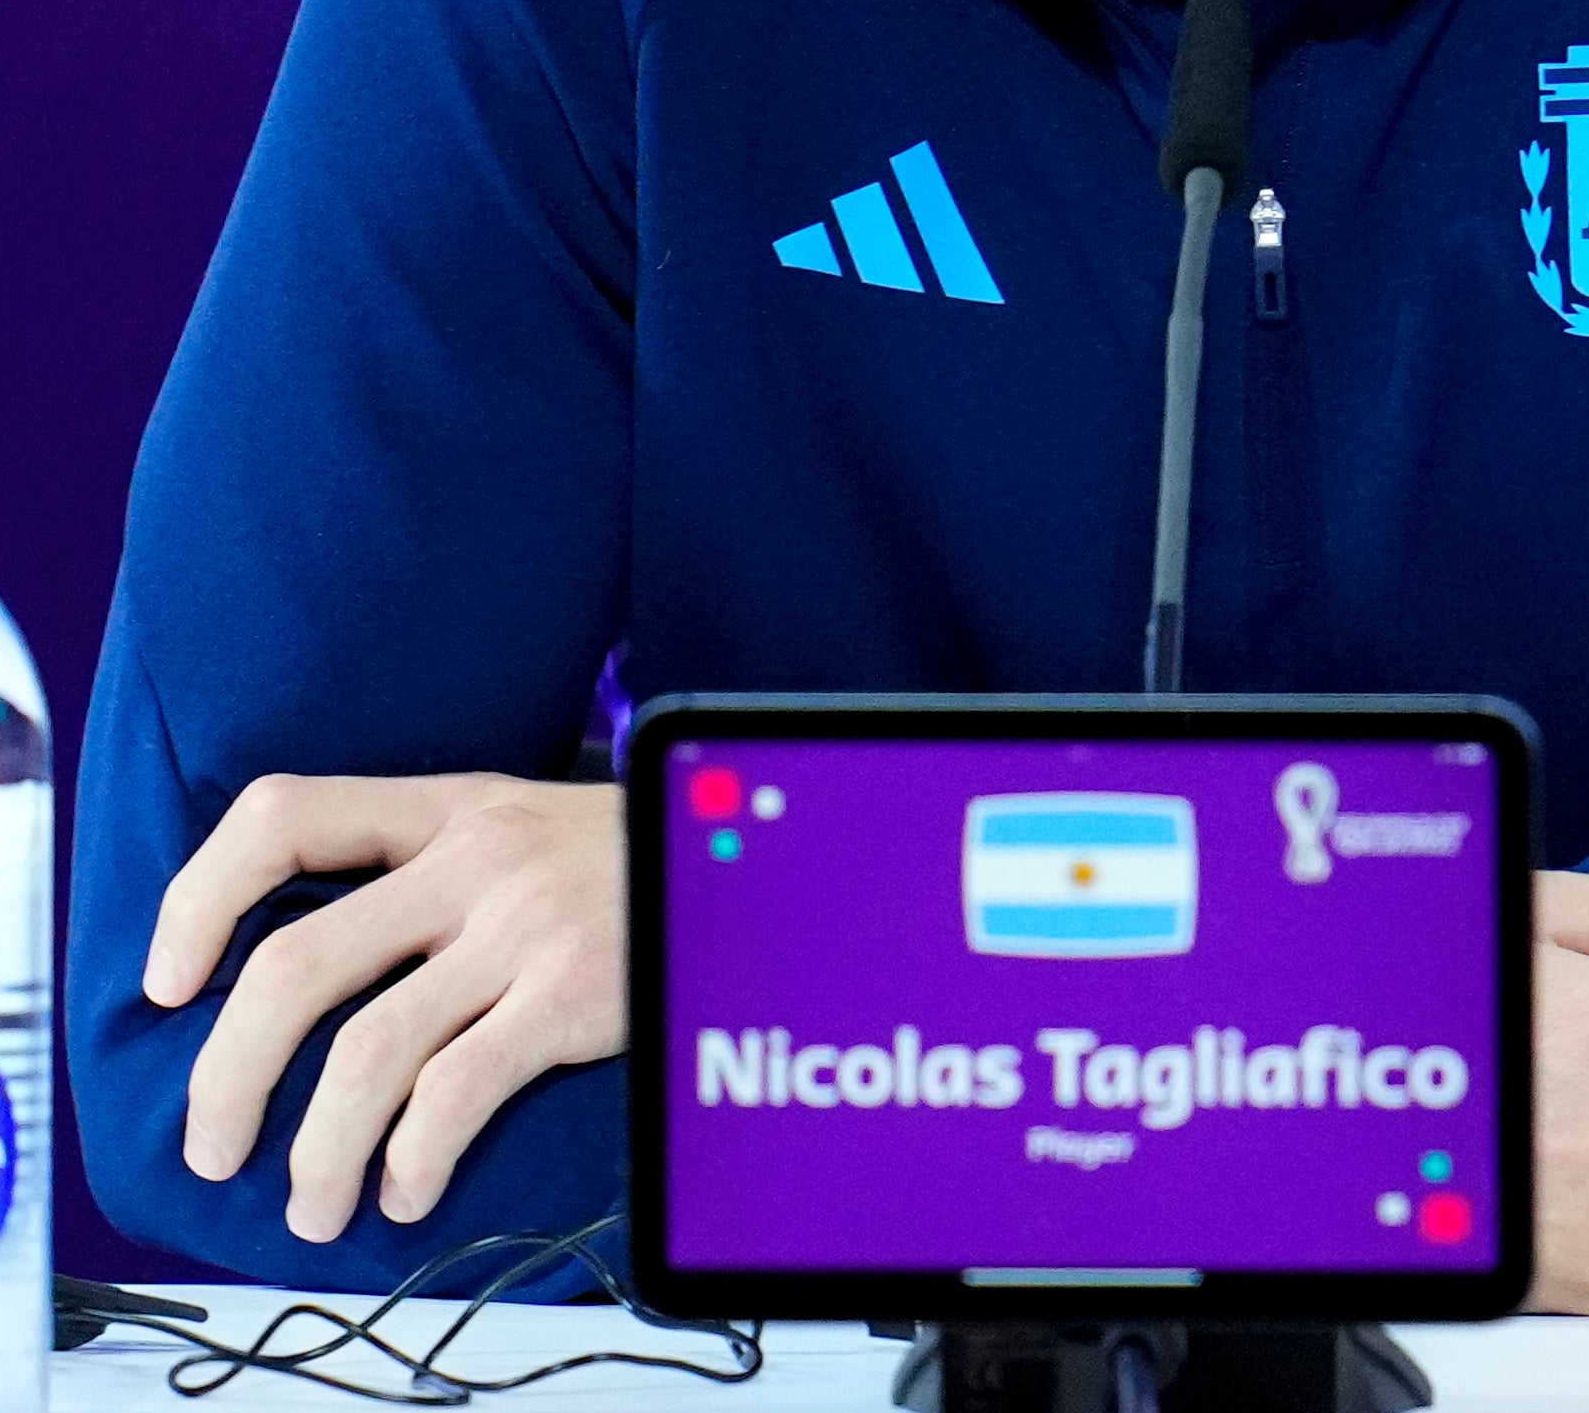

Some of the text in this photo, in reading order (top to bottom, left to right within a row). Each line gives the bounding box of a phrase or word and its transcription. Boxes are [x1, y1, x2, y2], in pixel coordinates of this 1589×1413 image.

[697, 1024, 1469, 1130] Nicolas Tagliafico
[1025, 1125, 1136, 1171] Player
